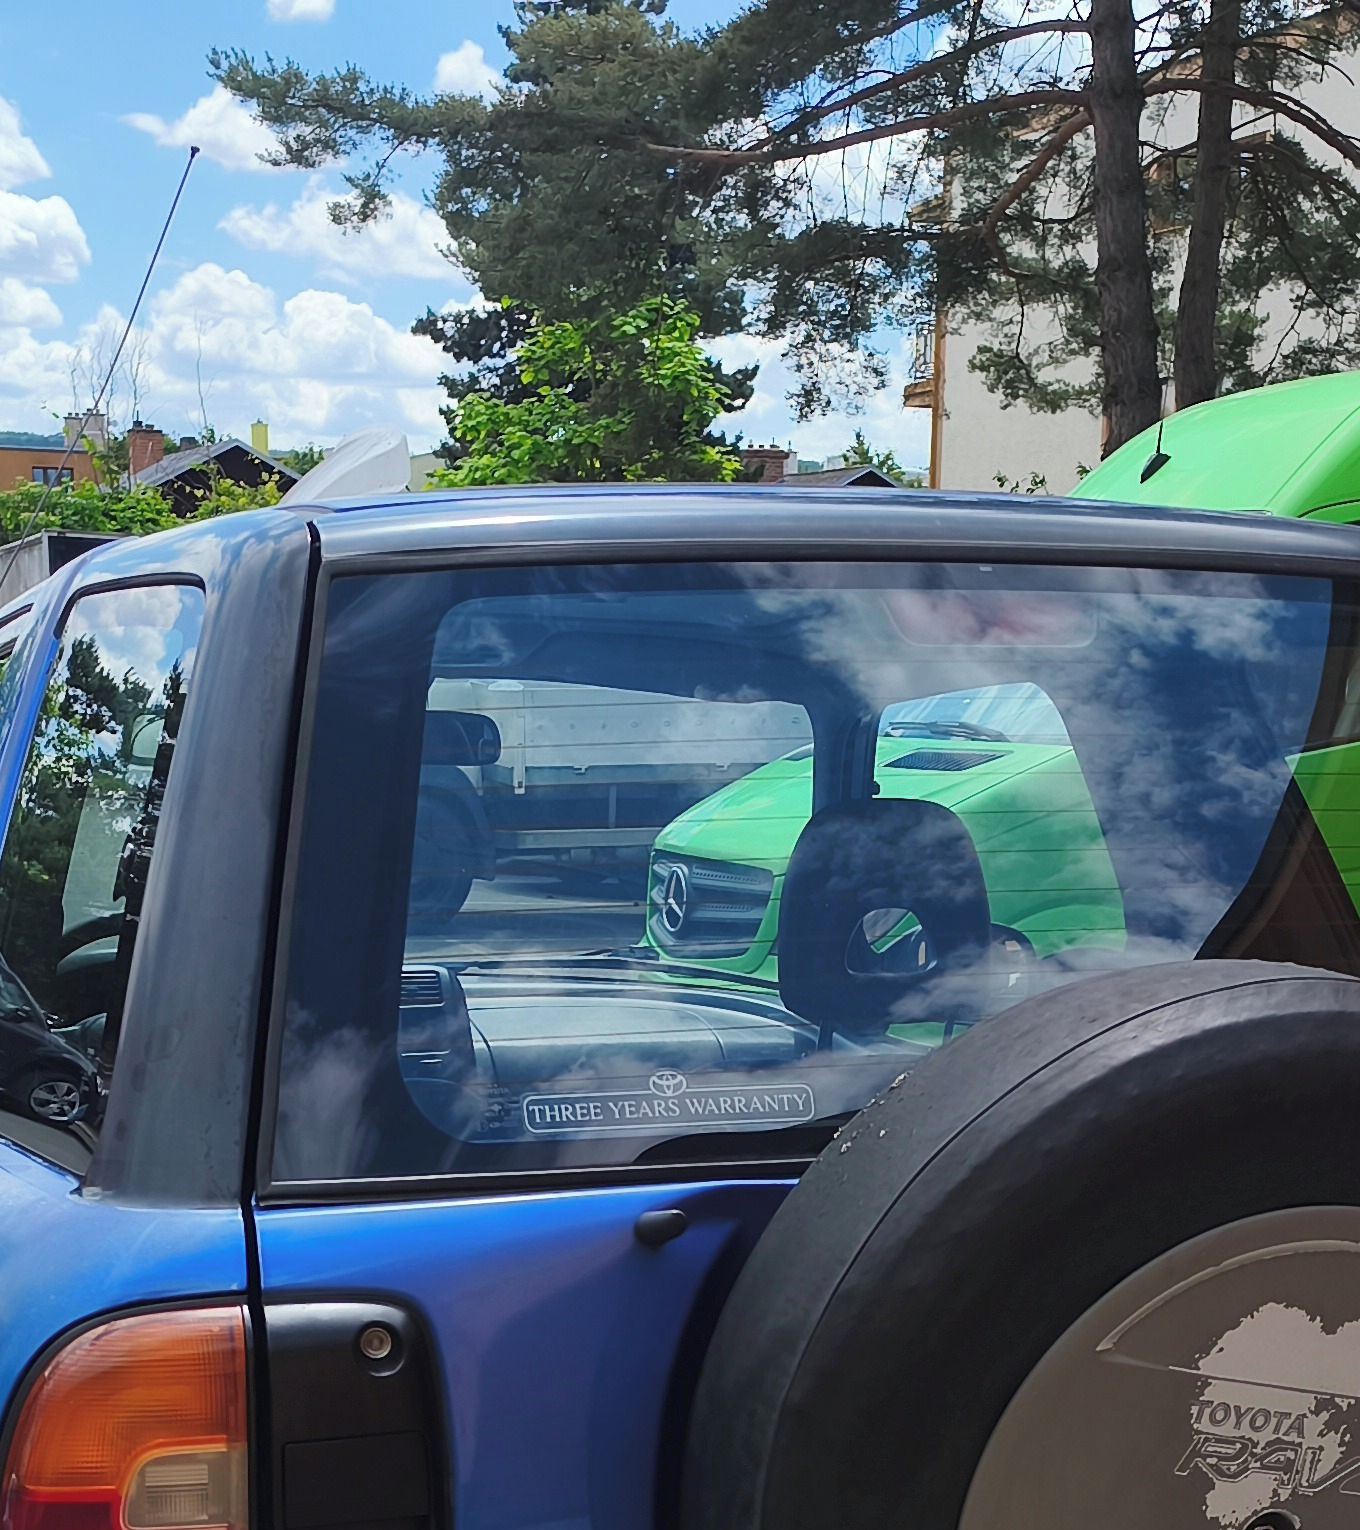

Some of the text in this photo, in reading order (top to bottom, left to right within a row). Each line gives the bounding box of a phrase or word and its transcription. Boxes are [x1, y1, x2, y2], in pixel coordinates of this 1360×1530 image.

[528, 1092, 808, 1124] THREE YEARS WARRANTY
[1190, 1401, 1306, 1440] TOYOTA
